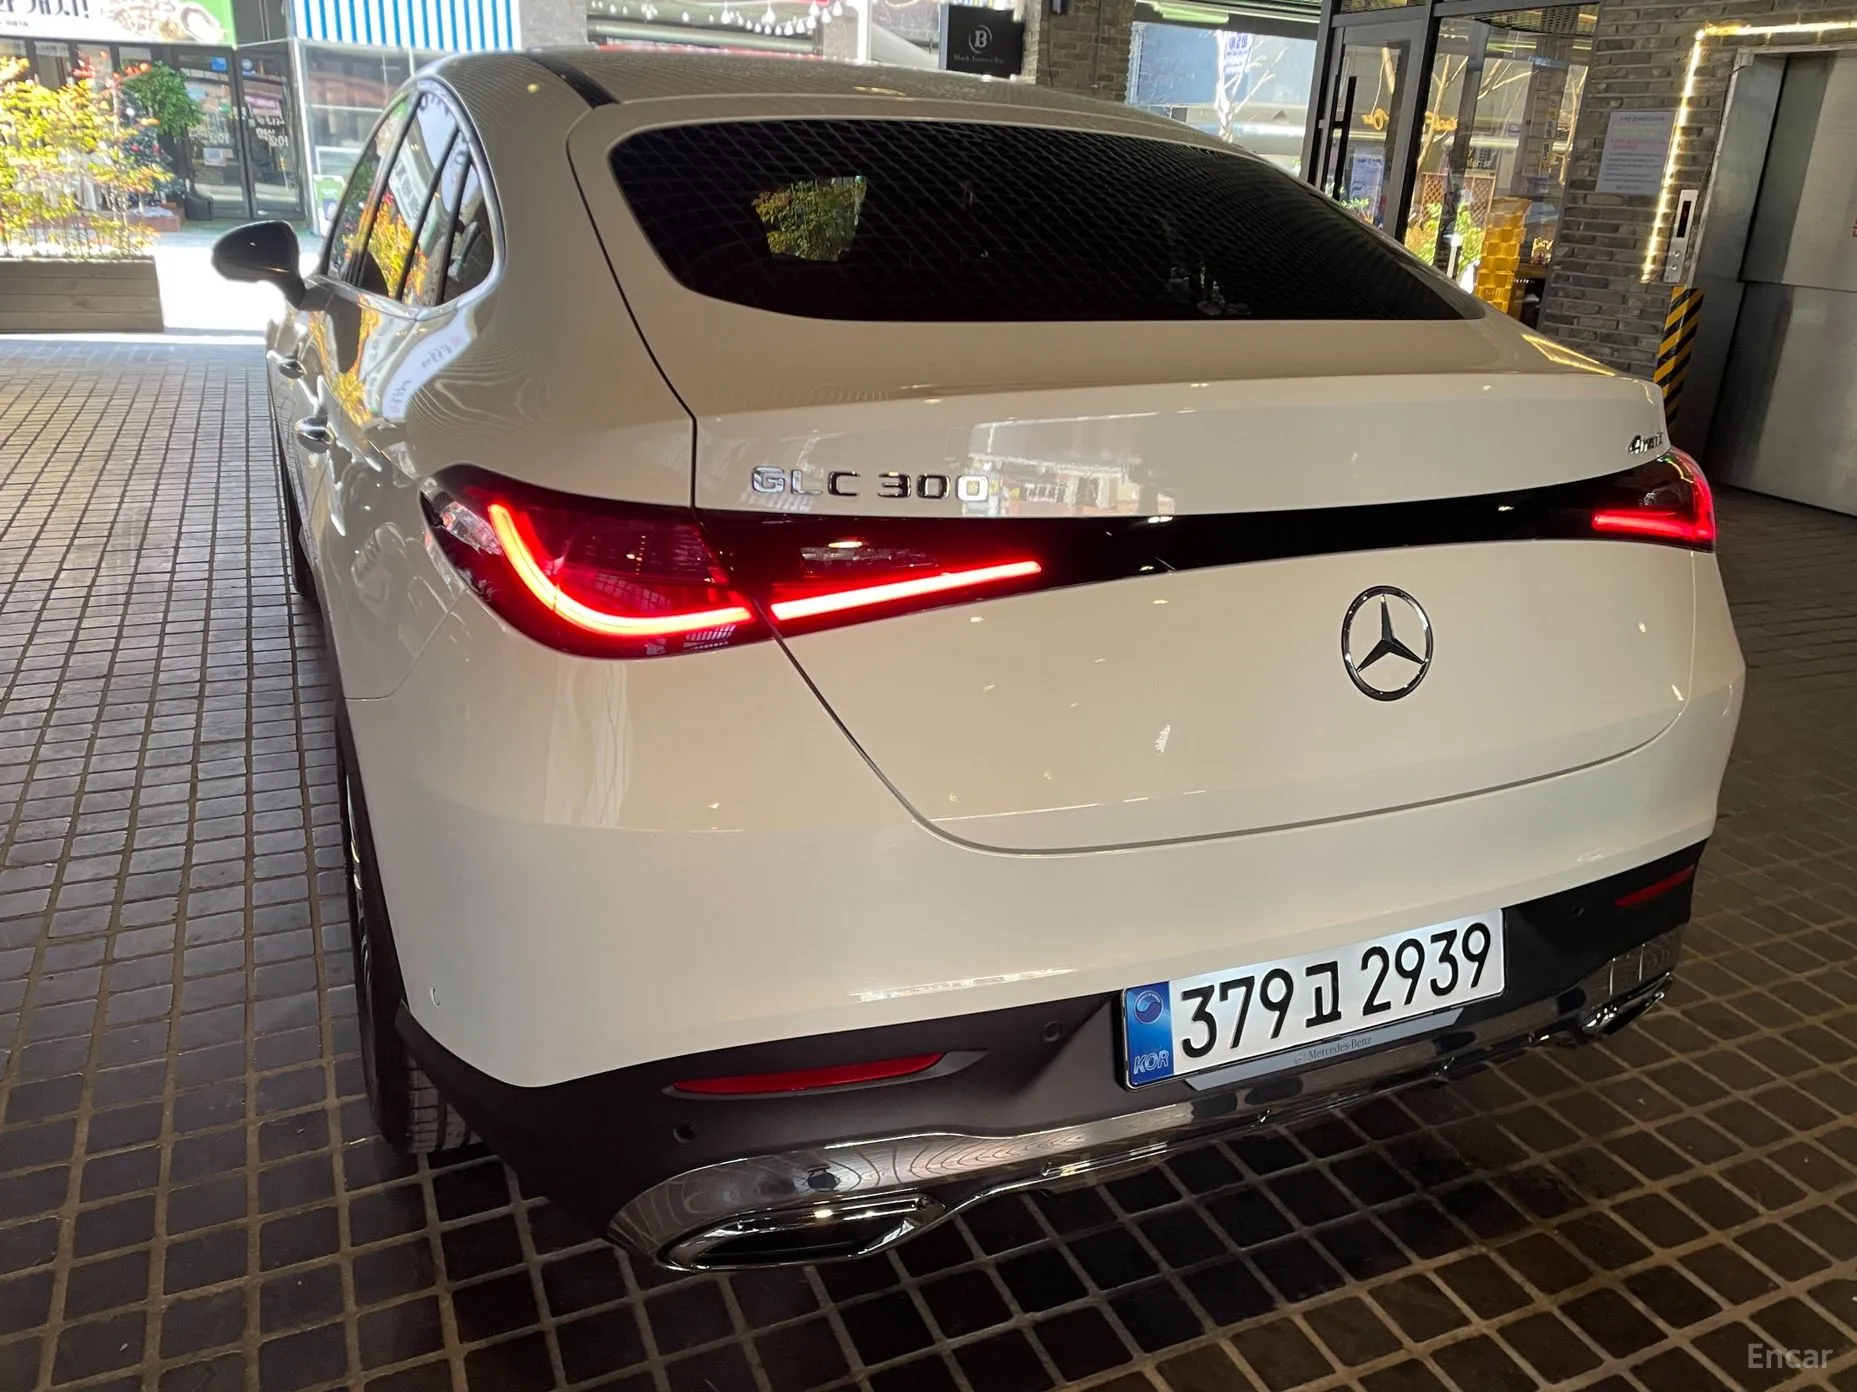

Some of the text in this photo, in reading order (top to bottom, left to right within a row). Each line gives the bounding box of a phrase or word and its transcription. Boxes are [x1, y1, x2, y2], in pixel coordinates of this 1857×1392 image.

[974, 29, 987, 48] B
[752, 466, 990, 501] GLC 300
[1181, 922, 1491, 1059] 379고 2939
[1308, 1037, 1372, 1060] Mercedes-Benz
[1133, 1049, 1169, 1075] KOR
